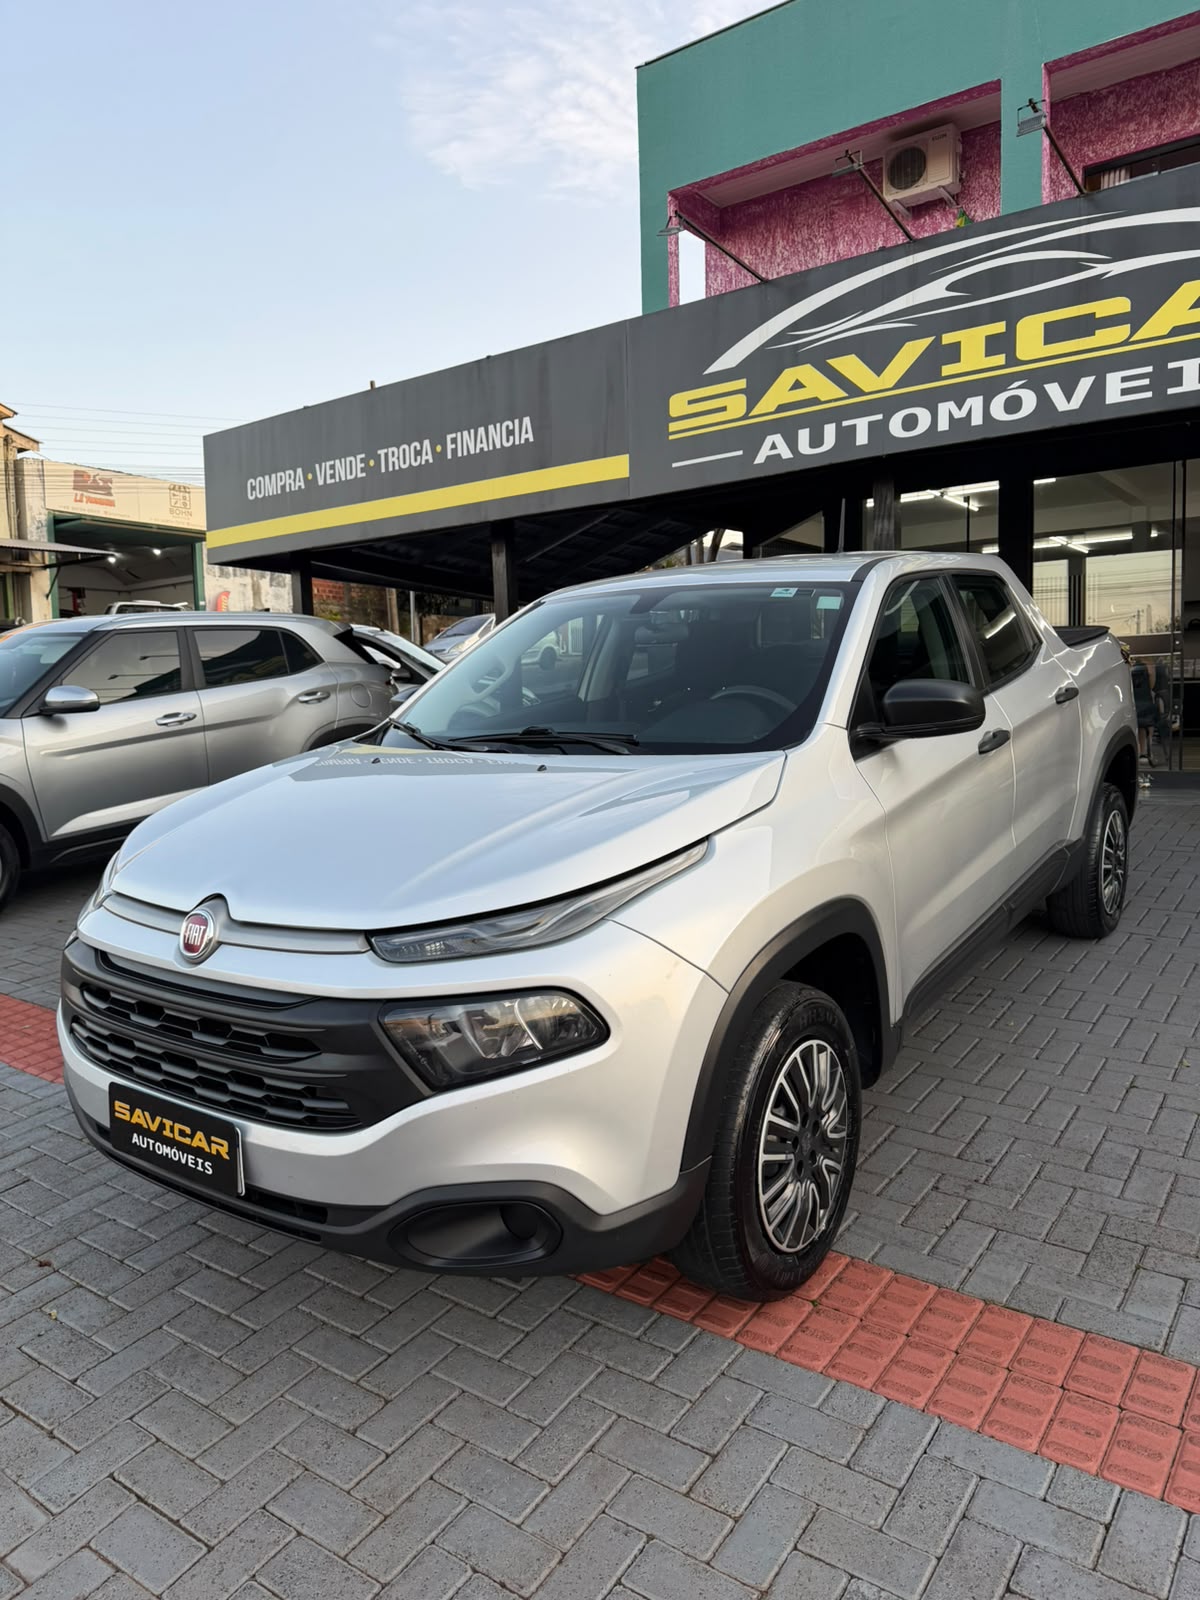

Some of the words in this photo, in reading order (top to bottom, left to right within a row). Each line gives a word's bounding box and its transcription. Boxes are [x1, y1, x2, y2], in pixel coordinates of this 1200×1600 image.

[753, 357, 1200, 465] AUTOMÓVEI
[247, 468, 305, 501] COMPRA
[315, 453, 366, 487] VENDE
[377, 439, 434, 474] TROCA
[446, 416, 534, 460] FINANCIA
[185, 923, 206, 947] FIAT
[114, 1100, 230, 1160] SAVICAR
[131, 1132, 213, 1175] AUTOMÓVEIS
